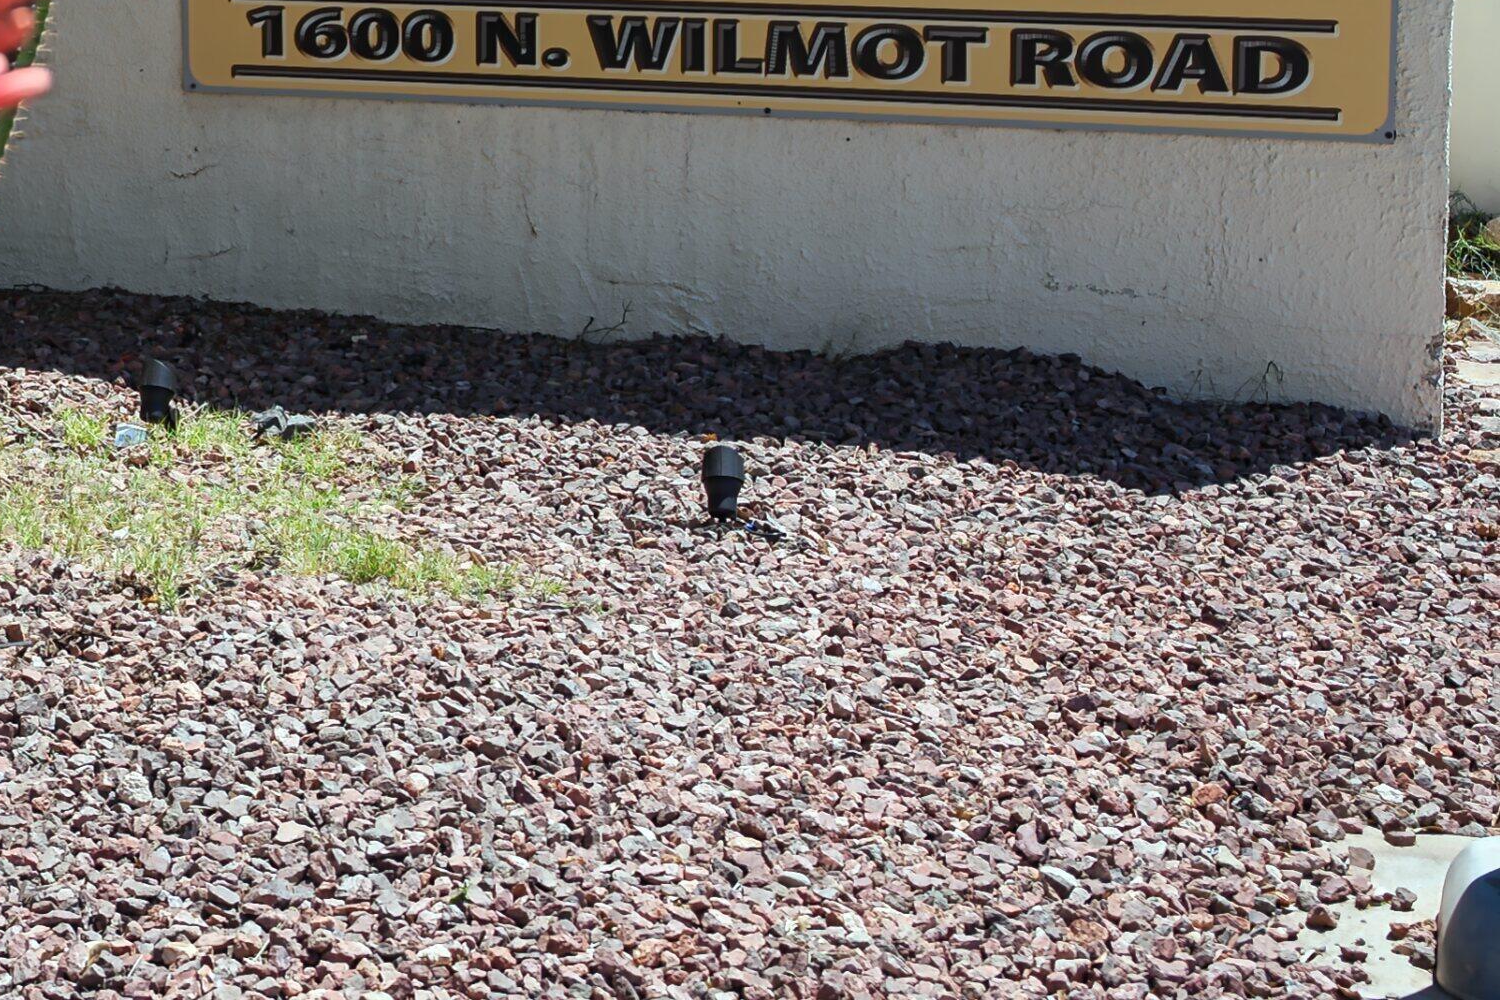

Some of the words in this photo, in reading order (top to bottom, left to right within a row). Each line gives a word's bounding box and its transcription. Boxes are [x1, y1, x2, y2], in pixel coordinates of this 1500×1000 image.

[246, 3, 454, 64] 1600
[477, 11, 570, 70] N.
[587, 15, 988, 82] WILMOT
[1011, 29, 1312, 96] ROAD
